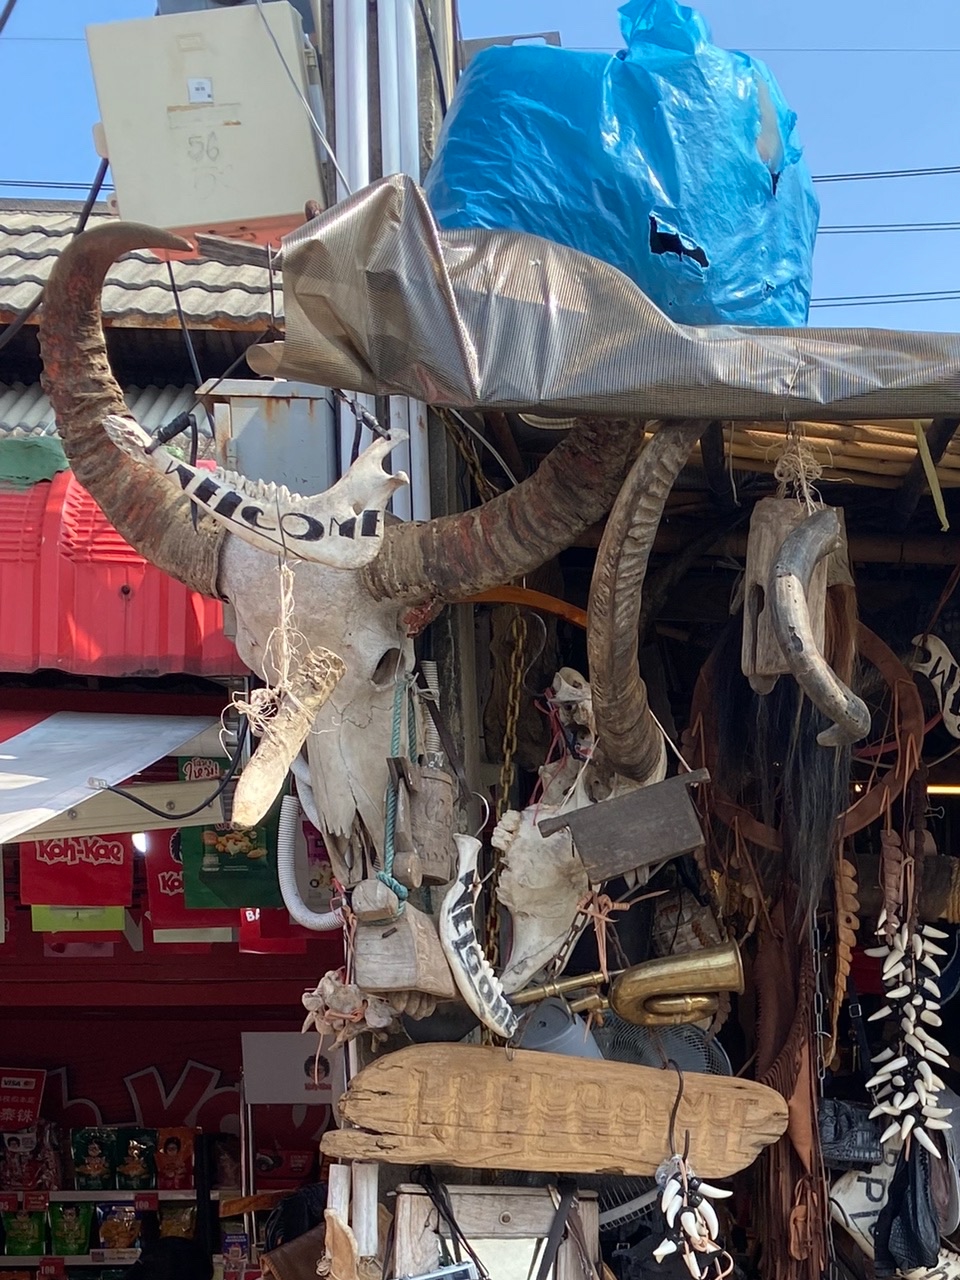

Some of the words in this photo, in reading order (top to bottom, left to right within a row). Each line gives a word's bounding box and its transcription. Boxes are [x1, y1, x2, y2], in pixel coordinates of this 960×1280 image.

[164, 460, 380, 542] WELCOME
[36, 836, 124, 865] Koh-Kae
[41, 1265, 55, 1275] 100
